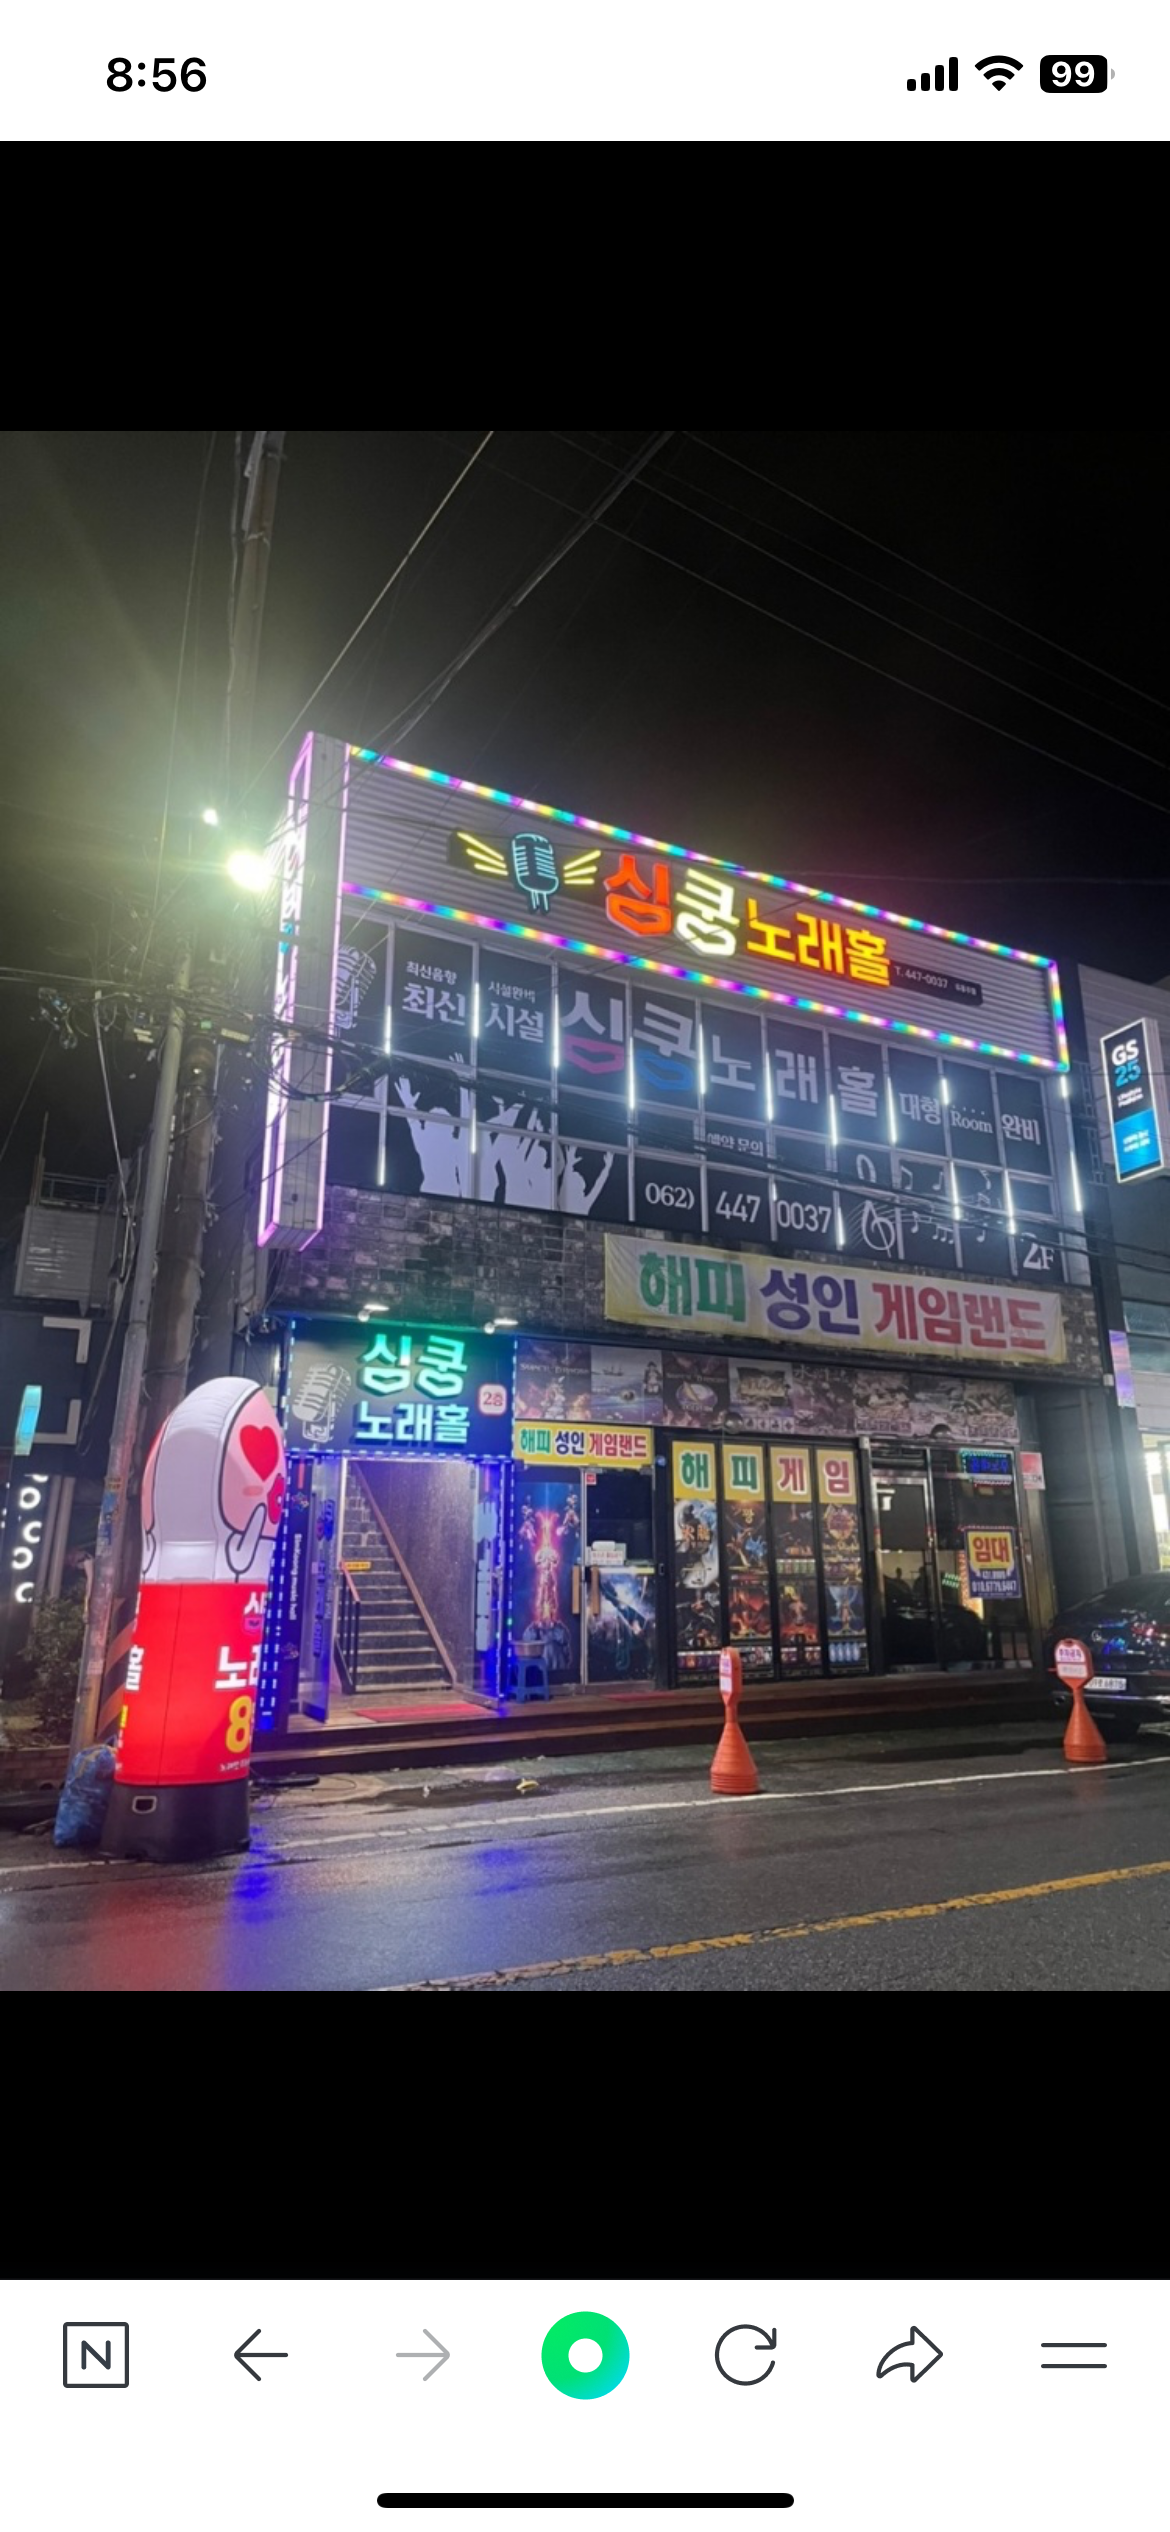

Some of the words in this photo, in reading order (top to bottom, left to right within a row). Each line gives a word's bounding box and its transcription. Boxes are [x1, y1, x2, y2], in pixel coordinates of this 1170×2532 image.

[402, 982, 465, 1026] 최신
[485, 1002, 544, 1043] 시설
[1111, 1039, 1139, 1066] GS
[1115, 1059, 1141, 1087] 25
[899, 1092, 941, 1125] 대형
[951, 1110, 993, 1133] Room
[1001, 1113, 1041, 1145] 완비
[639, 1252, 745, 1322] 해피
[760, 1269, 860, 1335] 성인
[872, 1282, 1046, 1350] 게임랜드
[355, 1401, 470, 1443] 노래홀
[520, 1428, 551, 1454] 해피
[555, 1431, 585, 1455] 성인
[589, 1433, 647, 1458] 게임랜드
[973, 1536, 1010, 1563] 임대
